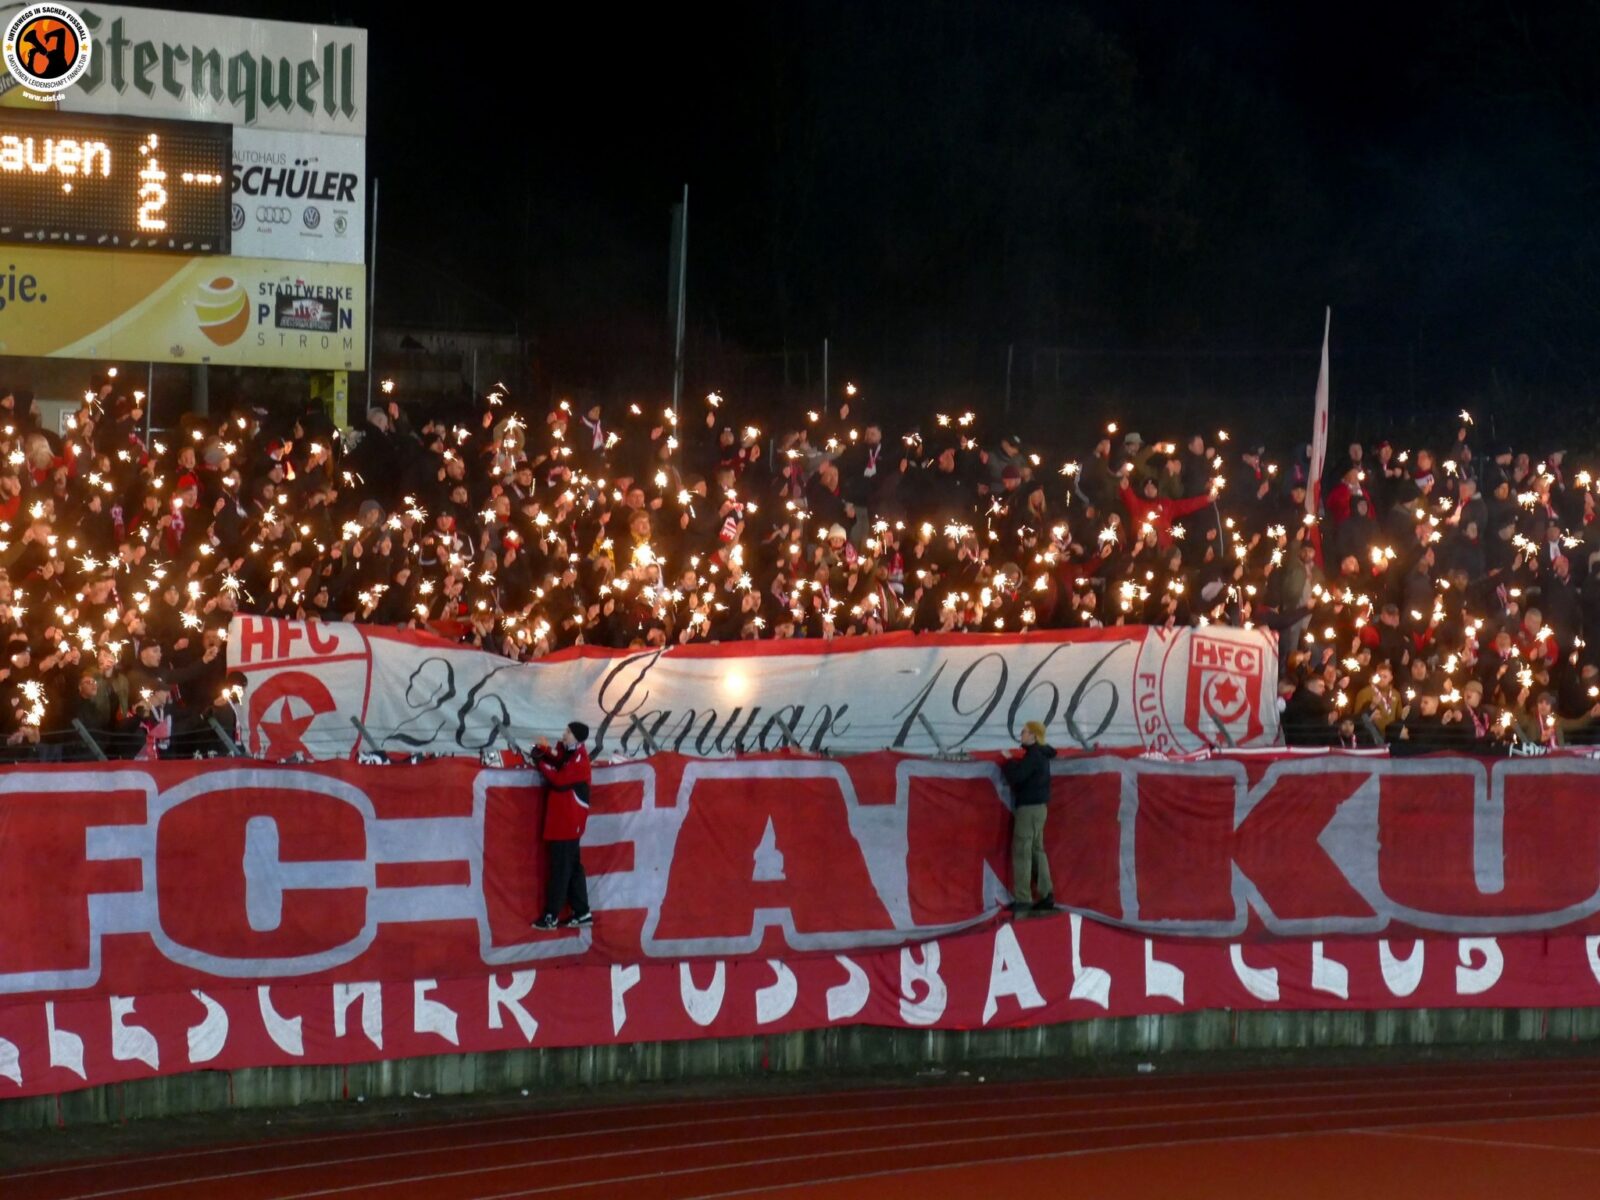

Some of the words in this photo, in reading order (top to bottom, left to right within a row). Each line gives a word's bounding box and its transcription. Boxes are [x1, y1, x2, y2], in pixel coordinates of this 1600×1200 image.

[232, 150, 287, 165] AUTOHAUS
[232, 158, 358, 202] SCHÜLER
[258, 282, 353, 301] STADTWERKE
[257, 332, 353, 351] STROM
[240, 617, 340, 664] HFC
[1194, 640, 1256, 672] HFC
[892, 640, 1132, 751] 1966
